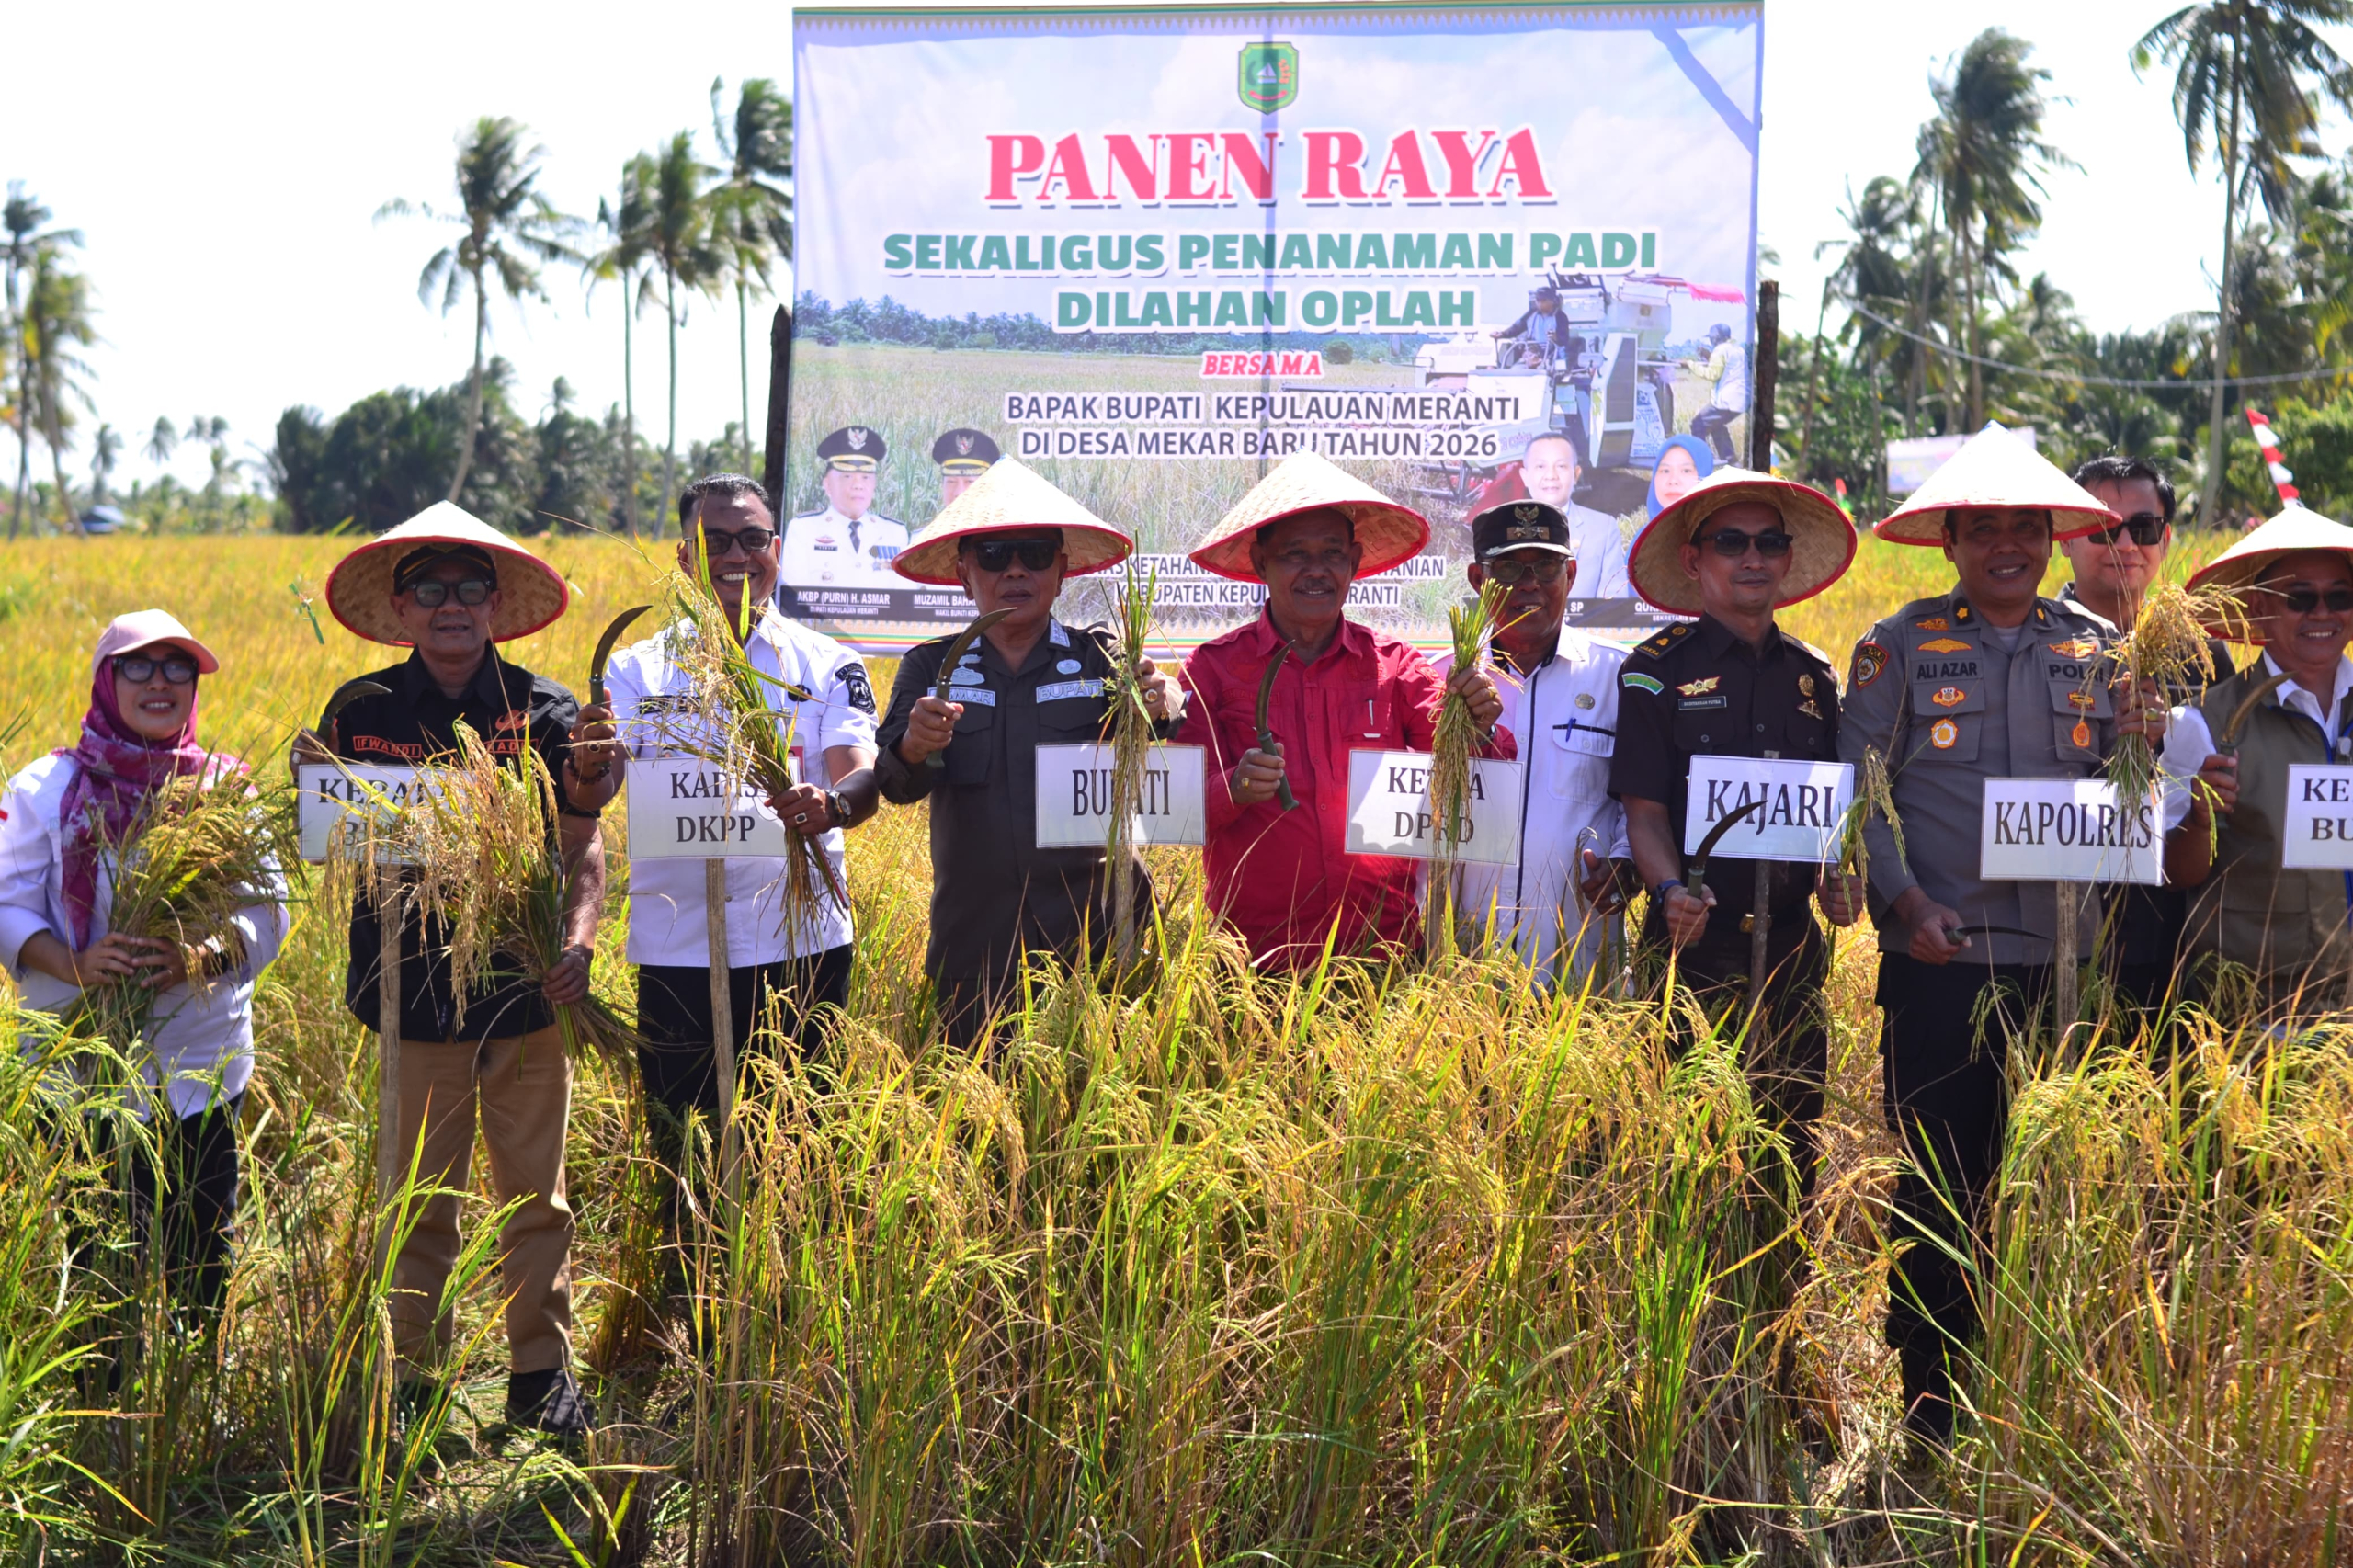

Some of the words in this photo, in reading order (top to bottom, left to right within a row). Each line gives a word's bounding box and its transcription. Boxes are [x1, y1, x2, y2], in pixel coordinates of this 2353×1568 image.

[984, 132, 1279, 201] PANEN
[1301, 129, 1552, 199] RAYA
[884, 233, 1164, 271] SEKALIGUS
[1178, 233, 1514, 270] PENANAMAN
[1529, 233, 1656, 269] PADI
[1057, 291, 1286, 327] DILAHAN
[1302, 290, 1474, 327] OPLAH
[1202, 352, 1322, 376] BERSAMA
[1007, 396, 1098, 419] BAPAK
[1107, 396, 1201, 420] BUPATI
[1216, 396, 1383, 420] KEPULAUAN
[1392, 397, 1519, 420] MERANTI
[1023, 432, 1049, 454] DI
[1059, 432, 1129, 455] DESA
[1138, 432, 1233, 455] MEKAR
[1245, 432, 1321, 456] BARU
[1324, 432, 1424, 456] TAHUN
[1429, 432, 1497, 456] 2026
[797, 590, 819, 602] AKBP
[821, 591, 849, 605] (PURN)
[851, 593, 859, 604] H.
[861, 593, 890, 605] ASMAR
[914, 594, 950, 606] MUZAMIL
[1119, 585, 1213, 602] KBUPATEN
[1346, 585, 1398, 604] RANTI
[1571, 602, 1584, 612] SP
[1917, 665, 1937, 680] ALI
[1940, 663, 1977, 678] AZAR
[1040, 682, 1103, 700] BUPATI
[1072, 769, 1171, 816] BUTI
[1388, 767, 1485, 800] KEA
[2302, 778, 2353, 801] KE
[1705, 778, 1835, 835] KAJARI
[676, 816, 756, 842] DKPP
[1994, 801, 2153, 849] KAPOLRES
